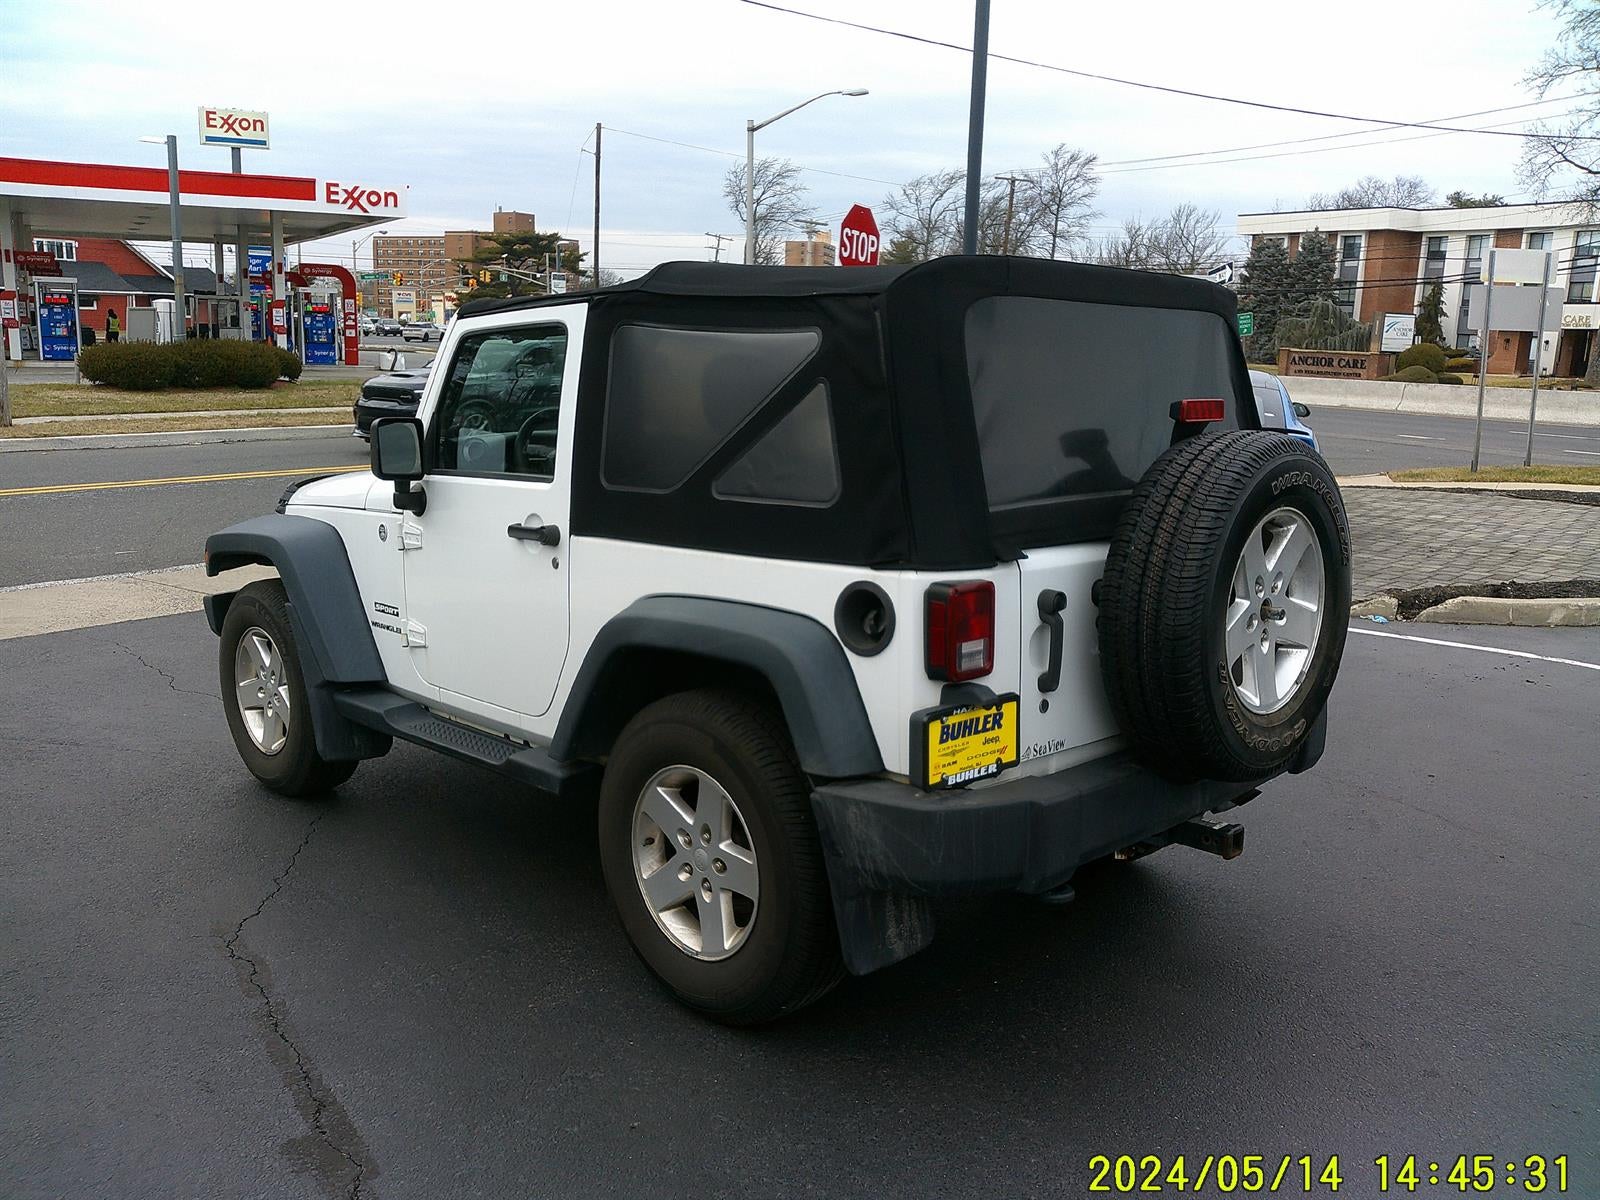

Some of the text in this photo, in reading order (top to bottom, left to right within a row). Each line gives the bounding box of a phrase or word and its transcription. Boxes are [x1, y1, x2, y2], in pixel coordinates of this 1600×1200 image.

[205, 110, 265, 136] Exxon
[325, 182, 398, 213] Exxon
[841, 227, 878, 263] STOP
[1563, 314, 1592, 324] CARE
[1290, 354, 1367, 369] ANCHOR CARE
[375, 602, 399, 617] SPORT
[939, 711, 1004, 746] BUHLER
[937, 741, 970, 753] CHRYSLER
[982, 735, 1001, 746] Jeep
[941, 760, 958, 769] RAM
[947, 763, 998, 785] BUHLER
